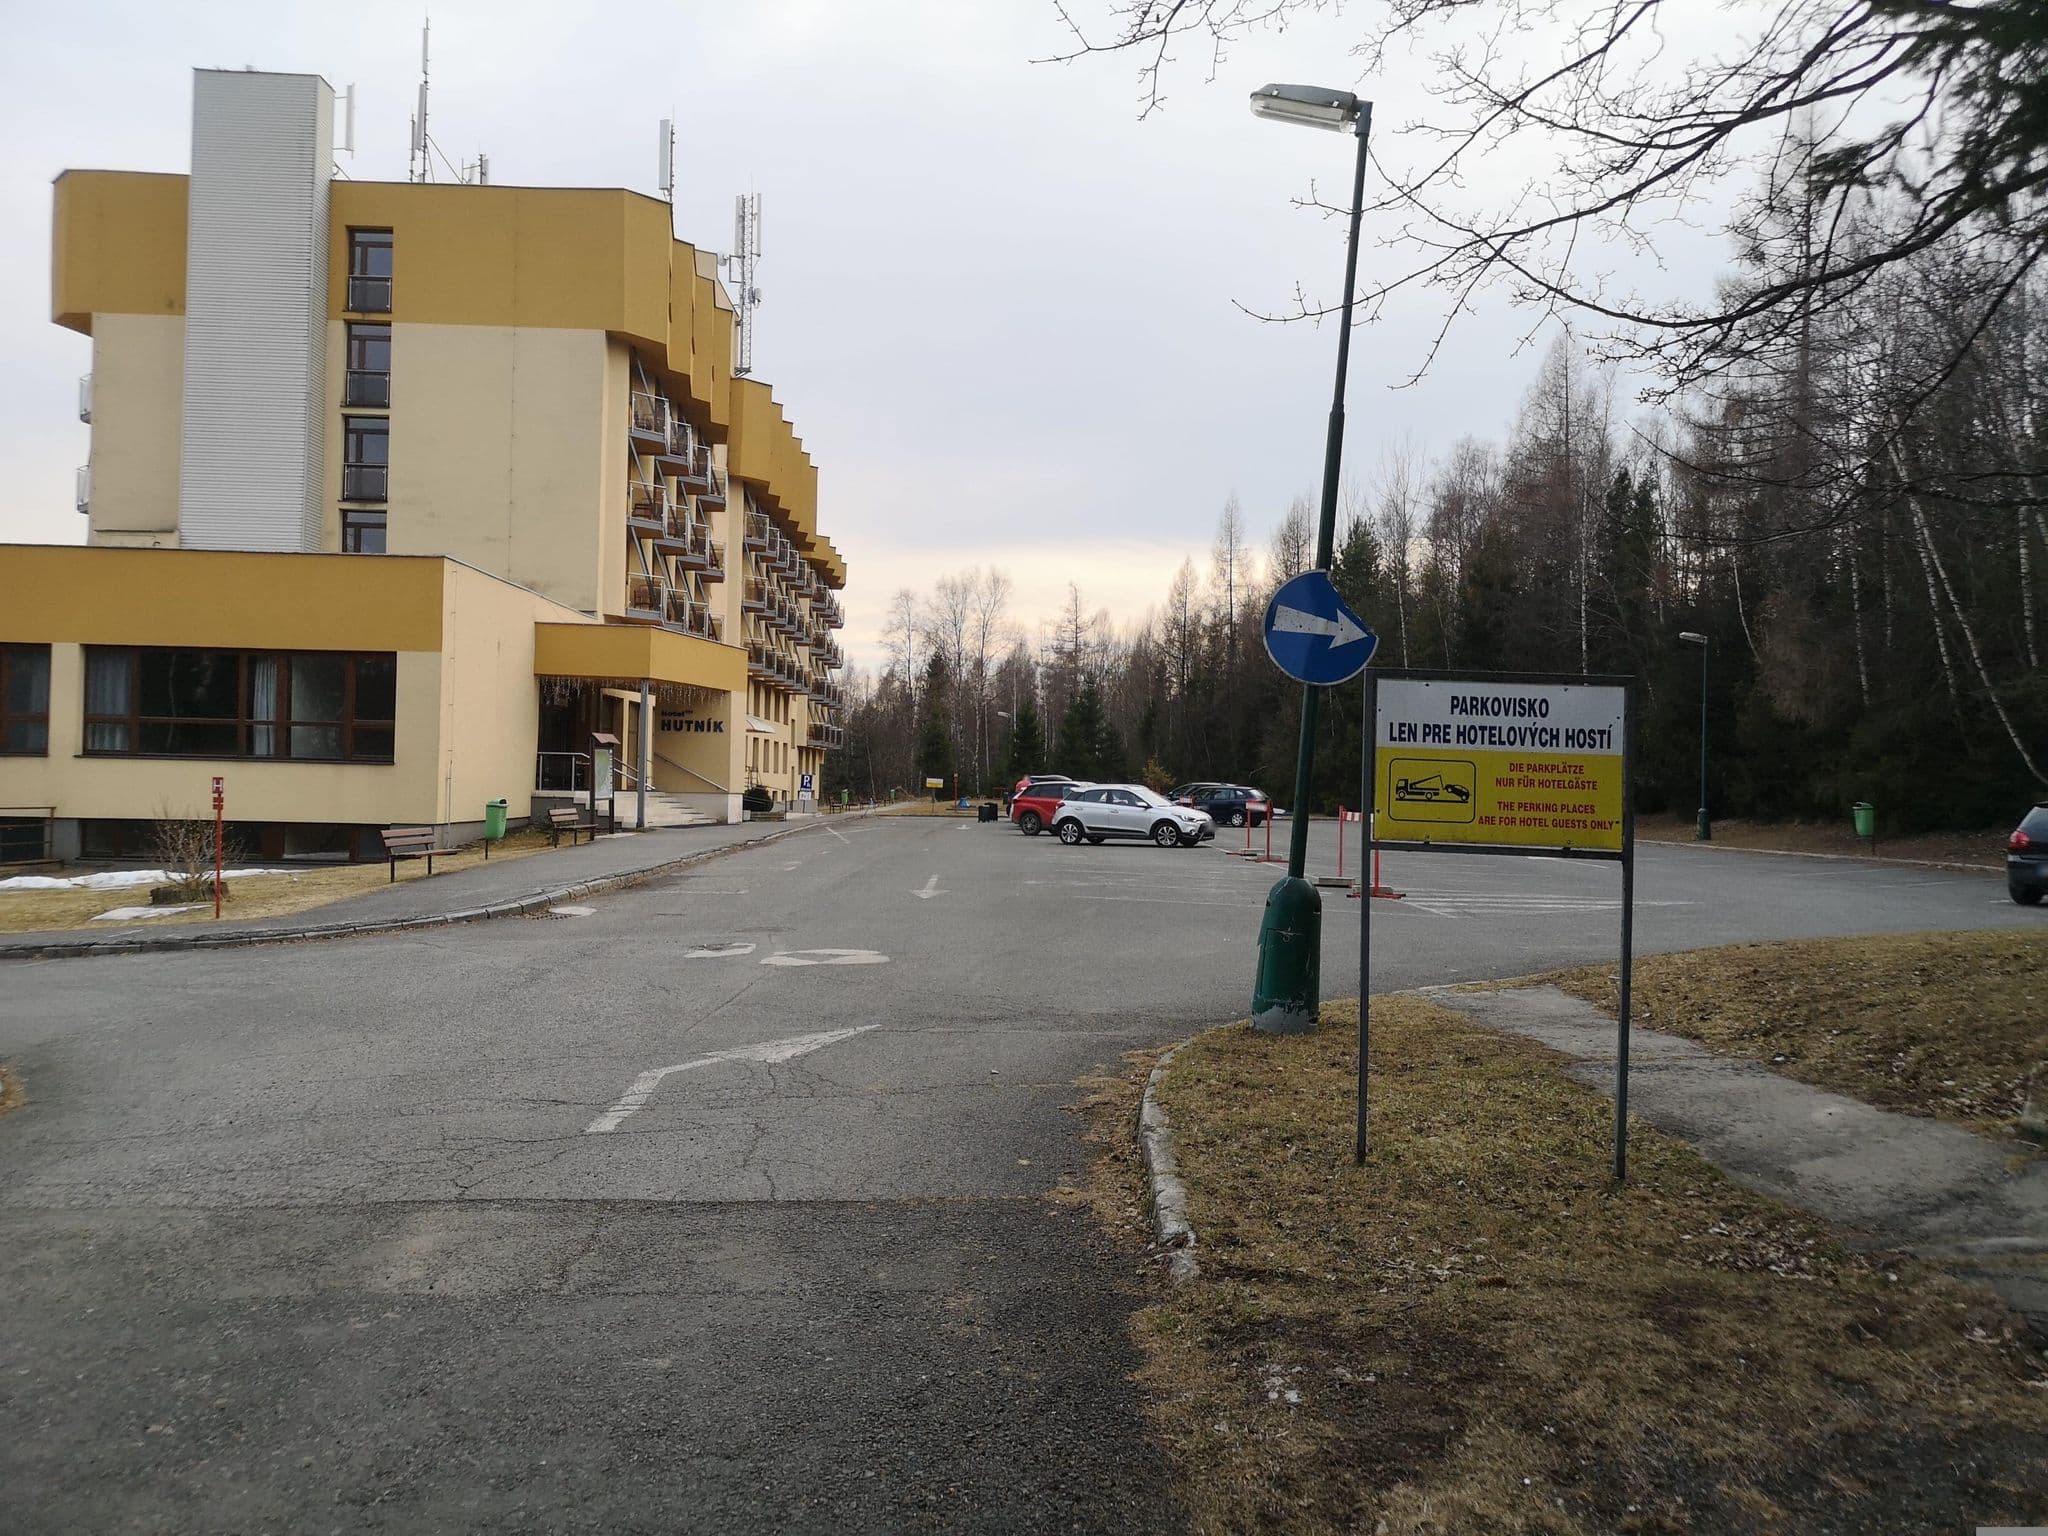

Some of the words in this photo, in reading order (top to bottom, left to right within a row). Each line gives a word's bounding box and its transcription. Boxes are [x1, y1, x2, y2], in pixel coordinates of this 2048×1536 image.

[1451, 696, 1549, 718] PARKOVISKO
[661, 718, 724, 732] HUTNÍK
[1390, 722, 1417, 743] LEN
[1423, 724, 1451, 744] PRE
[1457, 722, 1560, 747] HOTELOVÝCH
[1565, 725, 1612, 749] HOSTÍ
[1509, 763, 1524, 772] DIE
[1527, 762, 1584, 774] PARKPLÄTZE
[803, 775, 811, 786] P
[1496, 778, 1514, 788] NUR
[1518, 776, 1535, 789] FÜR
[1538, 777, 1598, 790] HOTELGÄSTE
[1497, 801, 1515, 811] THE
[1518, 802, 1557, 813] PERKING
[1561, 804, 1595, 814] PLACES
[1478, 816, 1496, 825] ARE
[1499, 817, 1517, 826] FOR
[1519, 817, 1549, 828] HOTEL
[1552, 819, 1588, 829] GUESTS
[1591, 820, 1613, 830] ONLY
